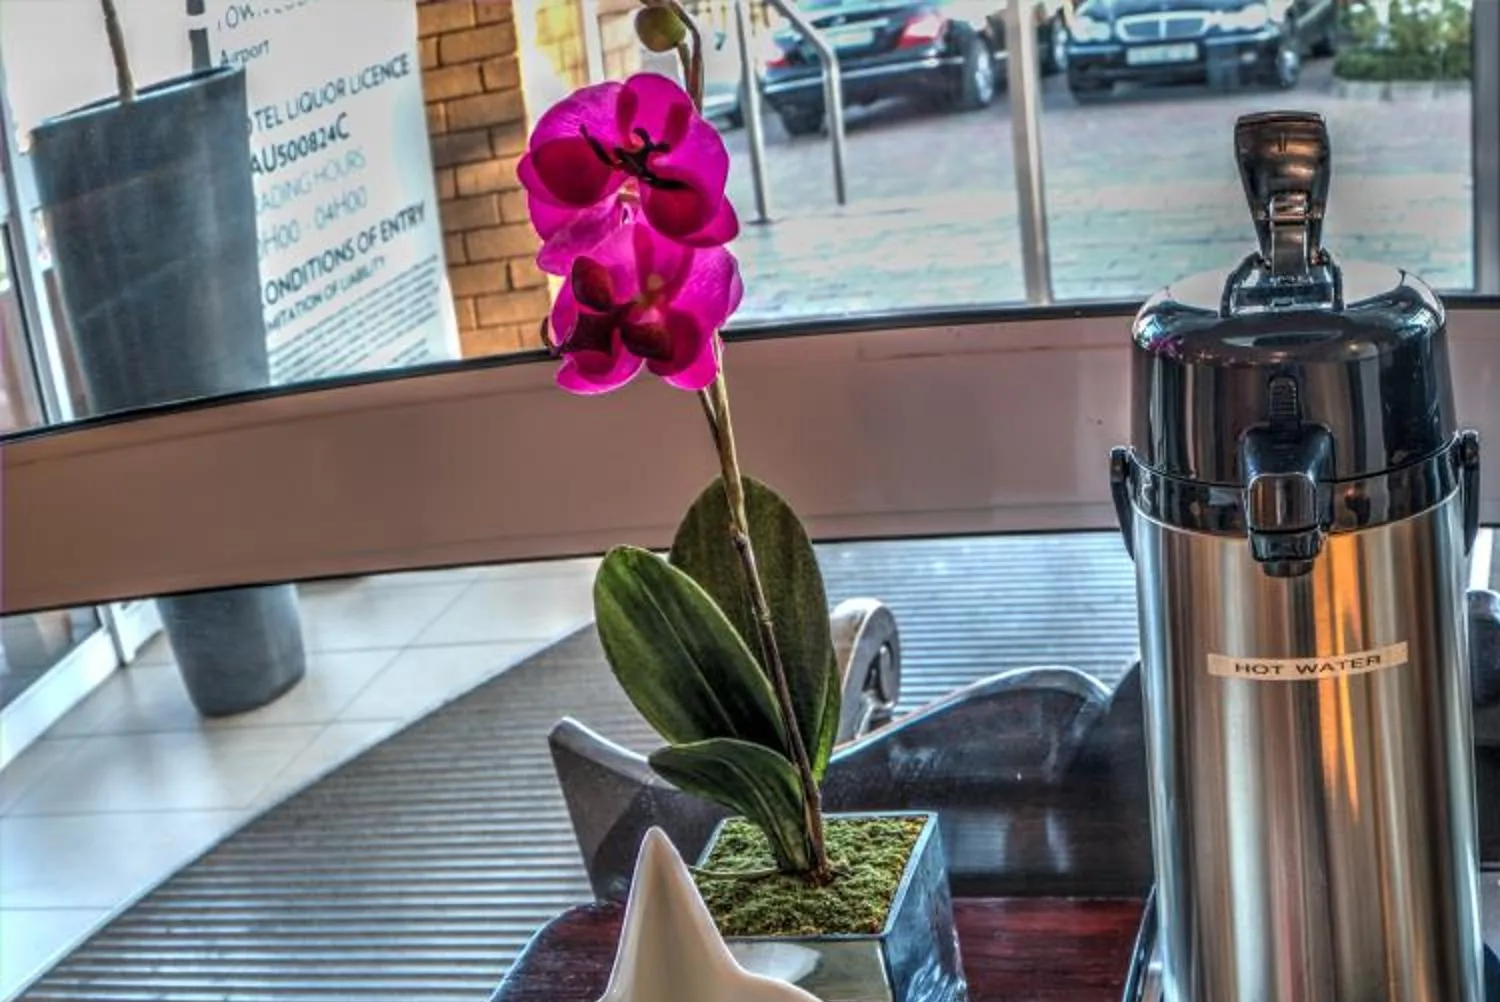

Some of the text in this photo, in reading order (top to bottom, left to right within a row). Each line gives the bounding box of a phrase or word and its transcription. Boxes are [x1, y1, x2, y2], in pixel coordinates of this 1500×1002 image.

[286, 77, 346, 121] LIQUOR
[350, 53, 411, 95] LICENCE
[357, 226, 377, 254] OF
[380, 201, 426, 243] ENTRY
[1235, 655, 1381, 675] HOT WATER
